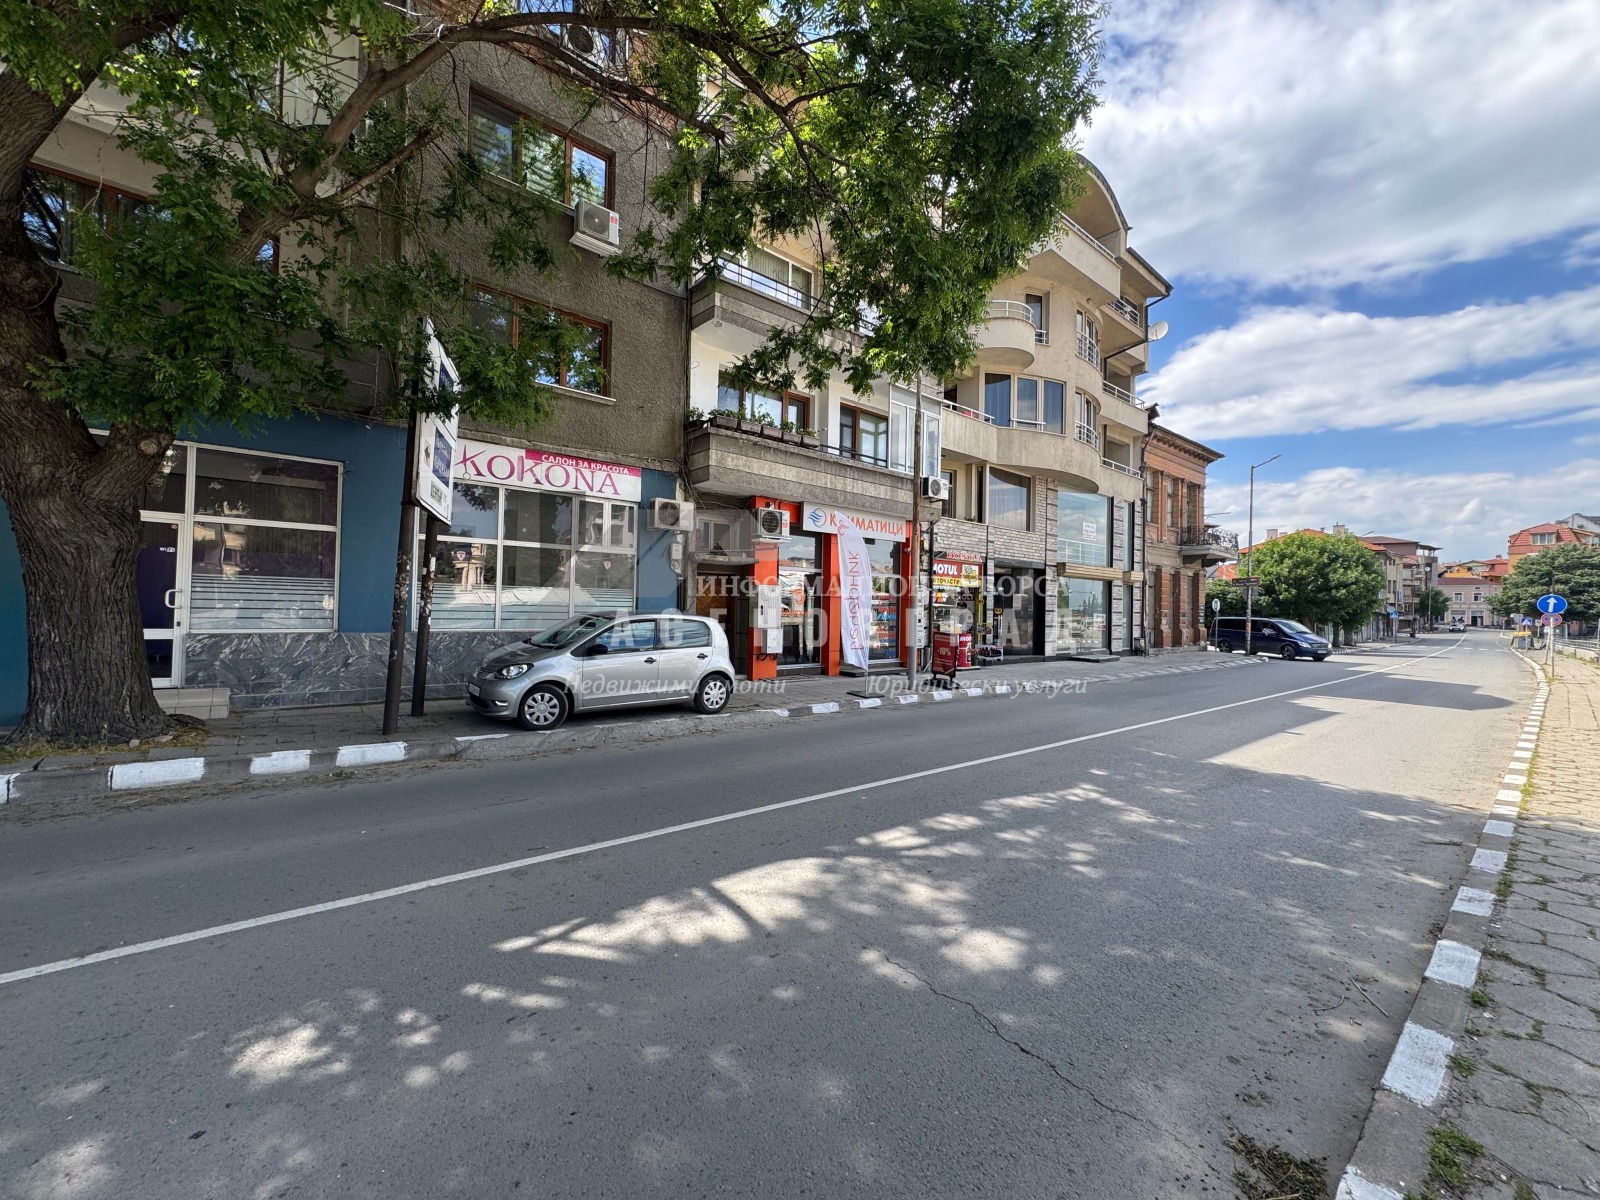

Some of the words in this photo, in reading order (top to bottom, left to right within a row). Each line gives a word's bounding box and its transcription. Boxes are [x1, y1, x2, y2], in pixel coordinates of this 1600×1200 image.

[455, 444, 621, 496] KOKONA
[541, 453, 576, 467] САЛОН
[578, 459, 590, 469] ЗА
[591, 462, 630, 476] КРАСОТА
[830, 517, 903, 536] КМАТИЦИ
[933, 576, 959, 585] ВТОЧАСТИ
